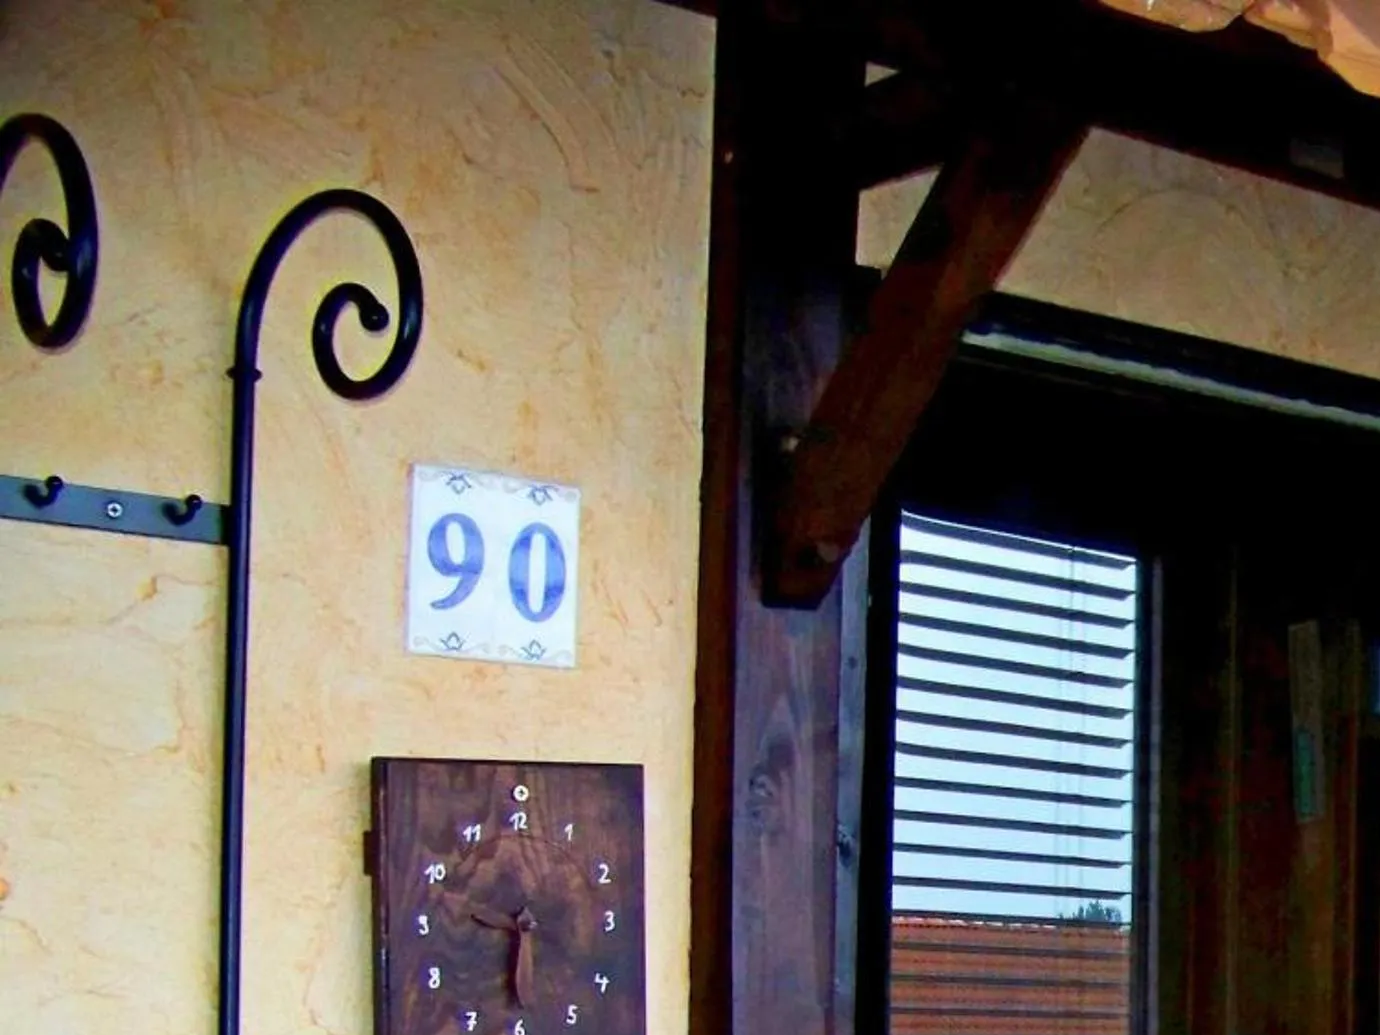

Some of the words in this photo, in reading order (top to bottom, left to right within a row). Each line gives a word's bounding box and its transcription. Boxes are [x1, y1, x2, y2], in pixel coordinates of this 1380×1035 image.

[427, 513, 566, 622] 90
[510, 810, 528, 831] 12
[463, 823, 481, 842] 11
[564, 822, 573, 841] 1
[424, 862, 446, 884] 10
[598, 862, 611, 884] 2
[418, 914, 429, 935] 9
[605, 910, 615, 932] 3
[428, 966, 440, 988] 8
[595, 973, 610, 994] 4
[465, 1011, 478, 1032] 7
[566, 1003, 578, 1025] 5
